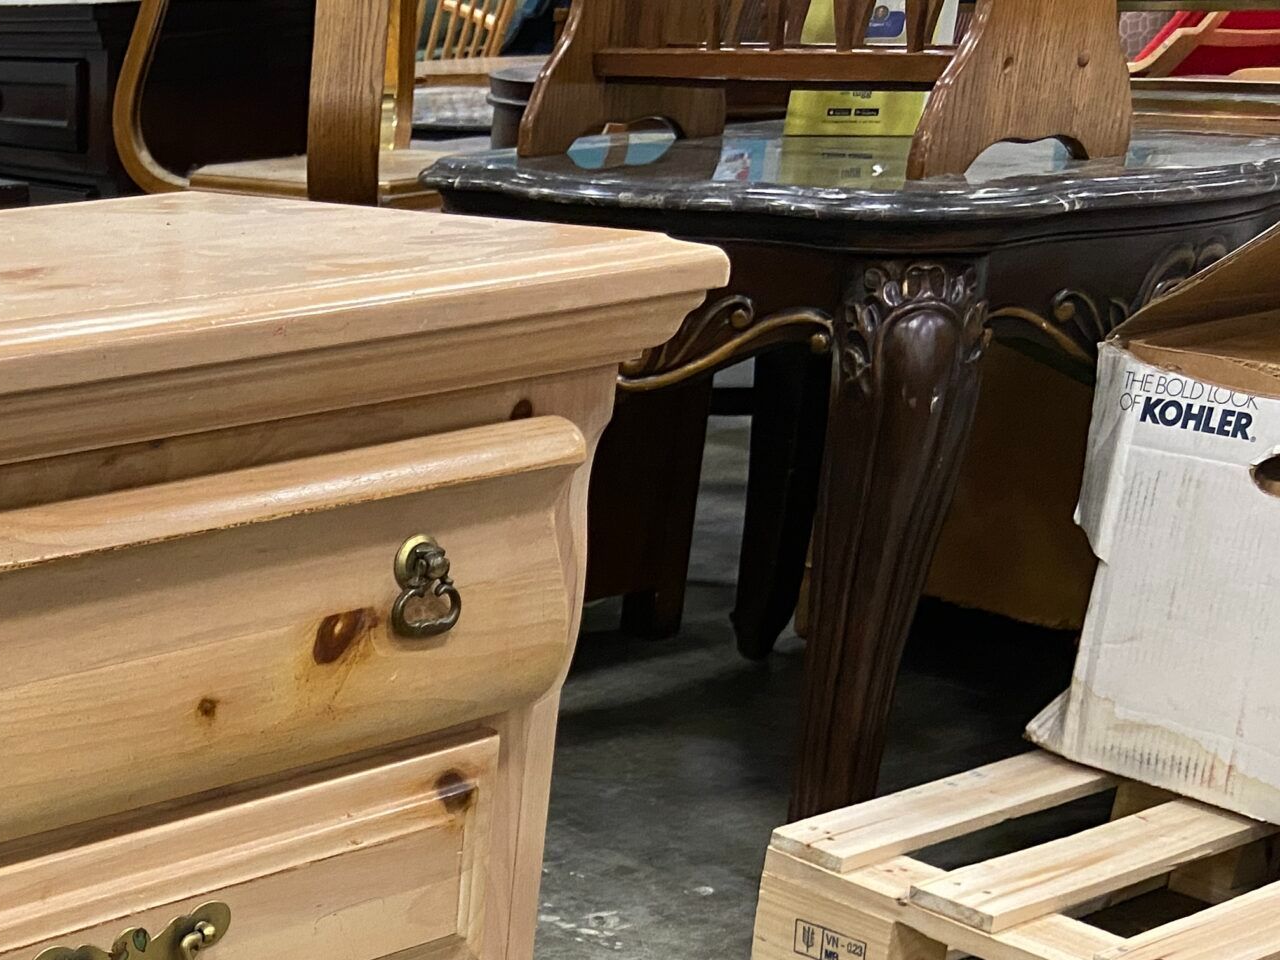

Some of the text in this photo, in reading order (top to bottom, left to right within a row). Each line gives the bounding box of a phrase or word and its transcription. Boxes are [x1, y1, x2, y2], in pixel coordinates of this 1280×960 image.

[1125, 371, 1154, 393] THE
[1155, 375, 1204, 400] BOLD
[1120, 392, 1253, 441] OF KOHLER
[825, 933, 839, 948] VN
